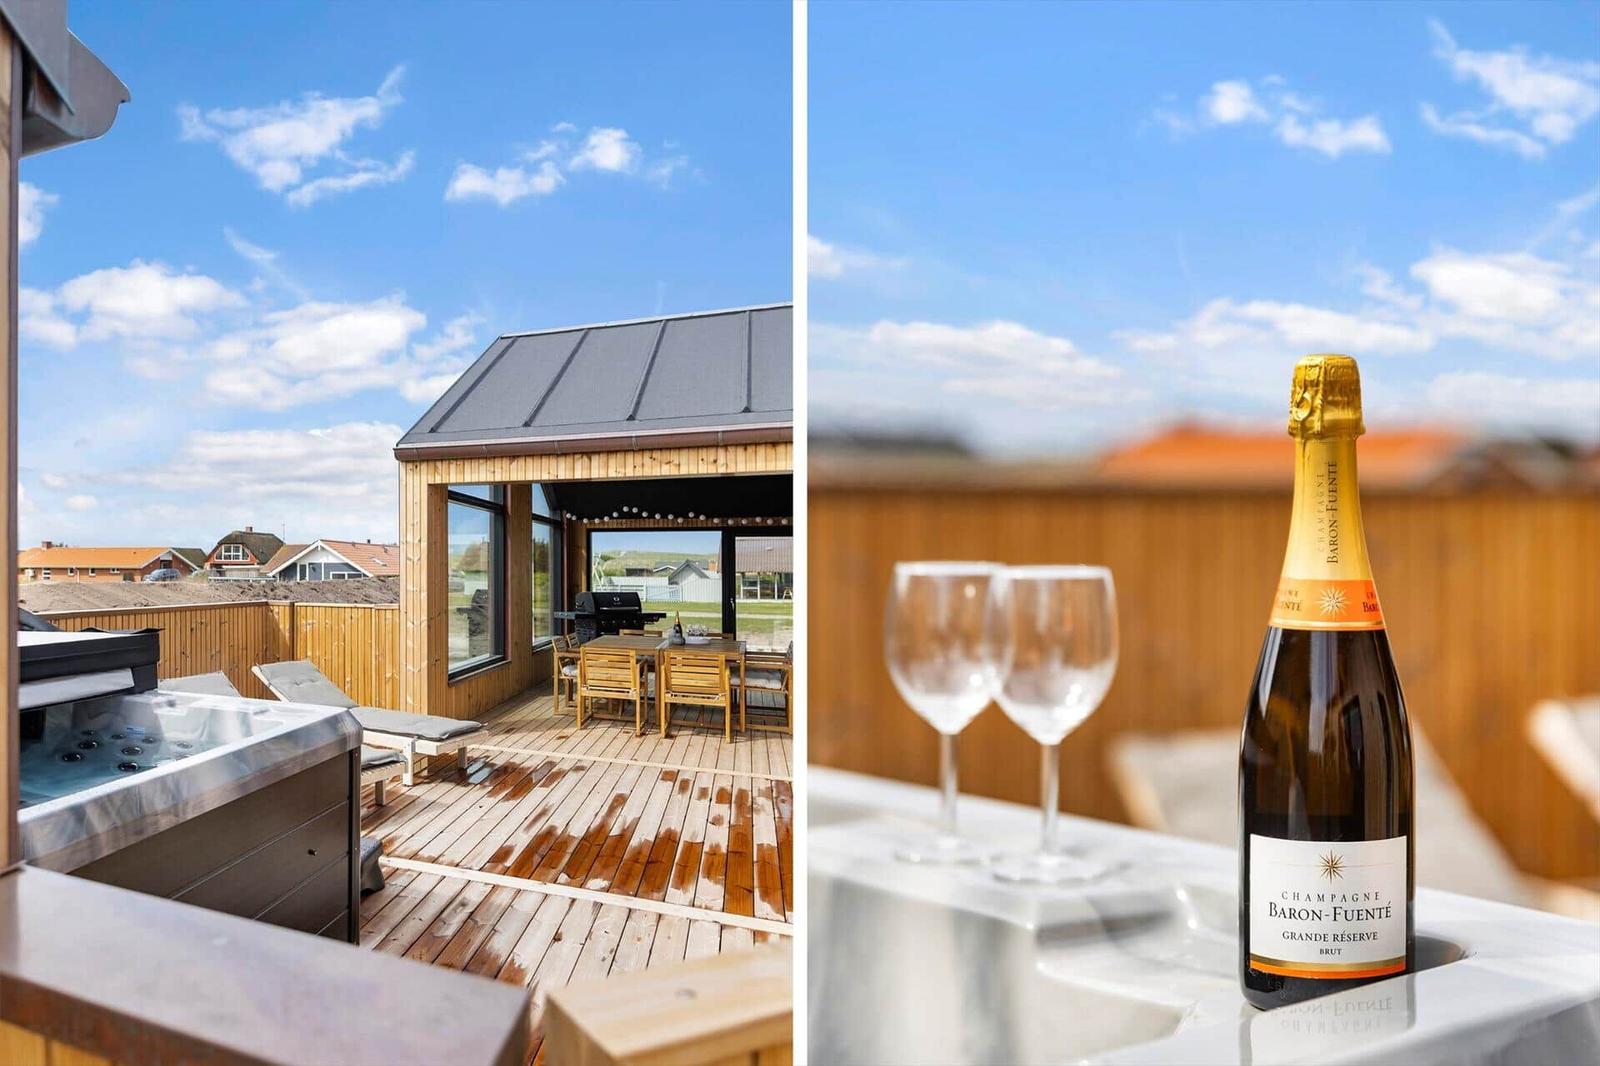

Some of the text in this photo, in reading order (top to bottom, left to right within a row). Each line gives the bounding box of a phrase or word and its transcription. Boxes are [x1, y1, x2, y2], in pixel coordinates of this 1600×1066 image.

[1281, 891, 1380, 903] CHAMPAGNE
[1268, 900, 1392, 922] BARON-FUENTÉ
[1282, 929, 1379, 943] GRANDE RÉSERVE
[1319, 948, 1342, 956] BRUT
